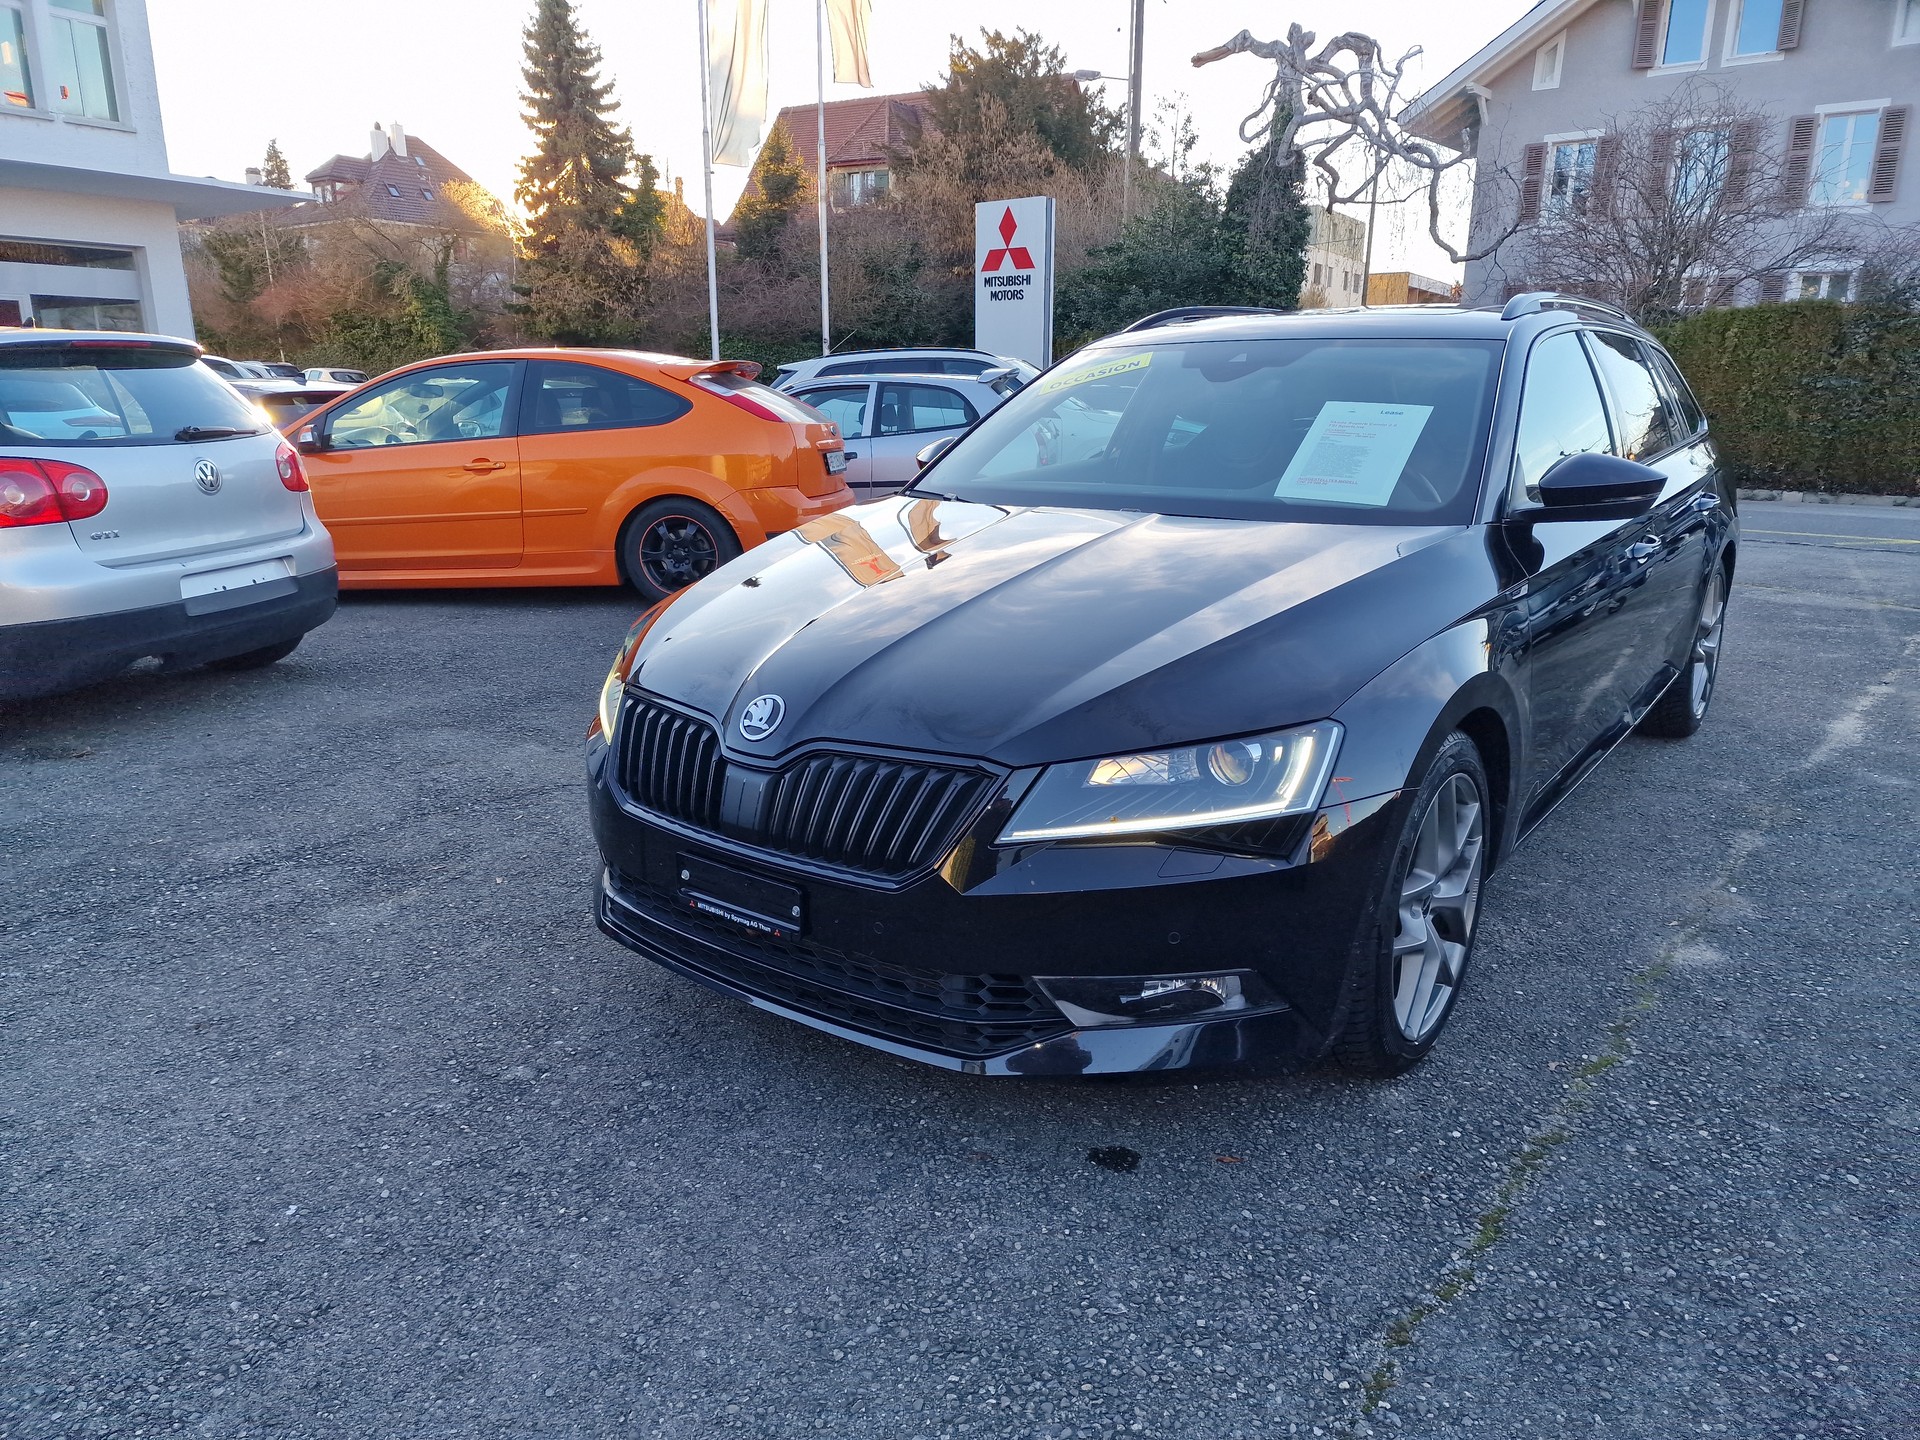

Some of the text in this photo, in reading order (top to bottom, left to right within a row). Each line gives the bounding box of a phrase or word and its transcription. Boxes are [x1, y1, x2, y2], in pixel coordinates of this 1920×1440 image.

[984, 274, 1031, 288] MITSUBISHI
[990, 289, 1025, 302] MOTORS
[1049, 359, 1141, 390] OCCASION
[90, 529, 120, 541] GTI
[697, 902, 724, 917] MITSUBISHI
[724, 911, 731, 920] by
[750, 920, 758, 928] AG
[759, 923, 771, 933] Thun
